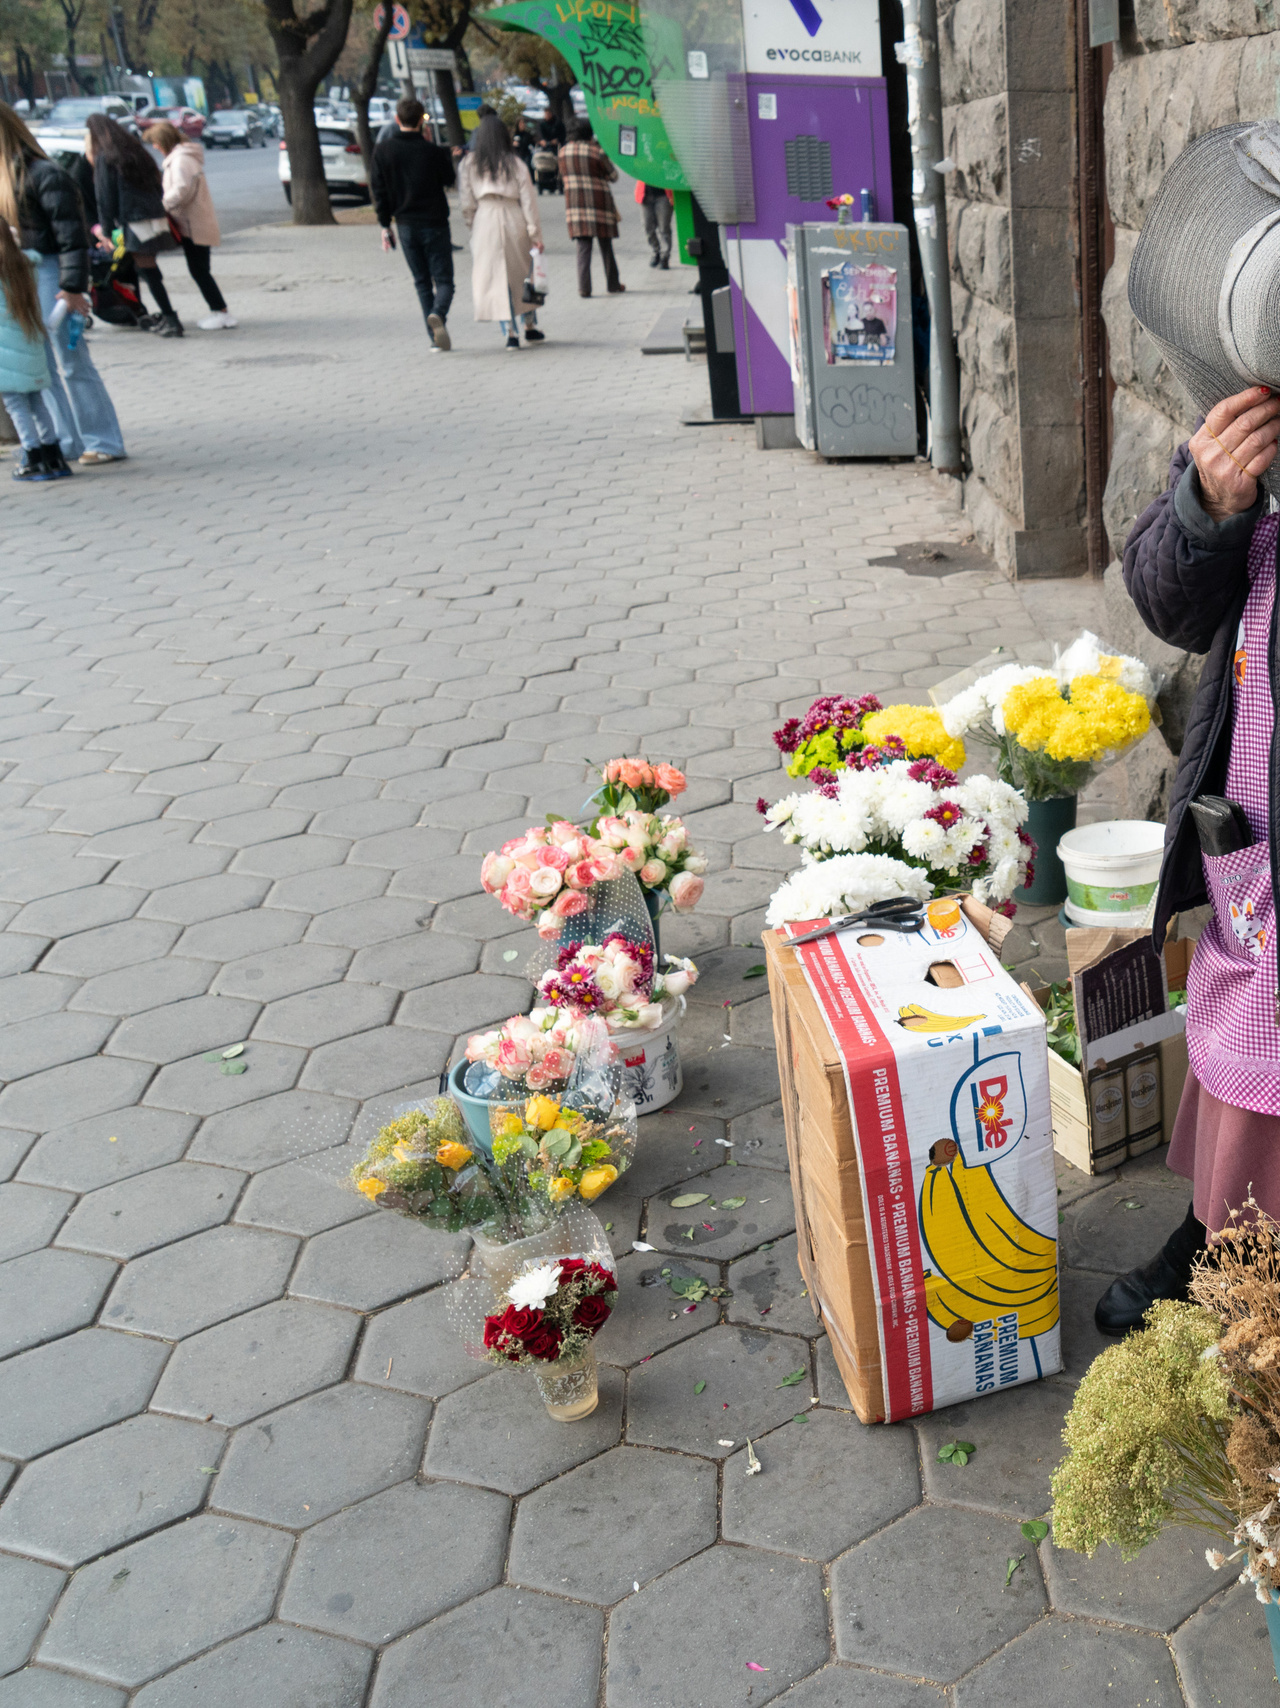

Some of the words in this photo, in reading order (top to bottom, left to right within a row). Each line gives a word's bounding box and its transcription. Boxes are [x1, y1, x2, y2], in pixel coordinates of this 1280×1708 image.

[823, 956, 847, 984] BANANAS
[837, 985, 863, 1015] PREMIUM
[850, 1014, 877, 1044] BANANAS
[873, 1068, 895, 1132] PREMIUM
[978, 1074, 1013, 1149] Dole
[882, 1133, 904, 1194] BANANAS
[892, 1202, 911, 1258] PREMIUM
[898, 1258, 917, 1314] BANANAS
[905, 1318, 921, 1368] PREMIUM
[974, 1320, 995, 1392] BANANAS
[997, 1313, 1019, 1385] PREMIUM
[909, 1367, 924, 1413] BANANAS
